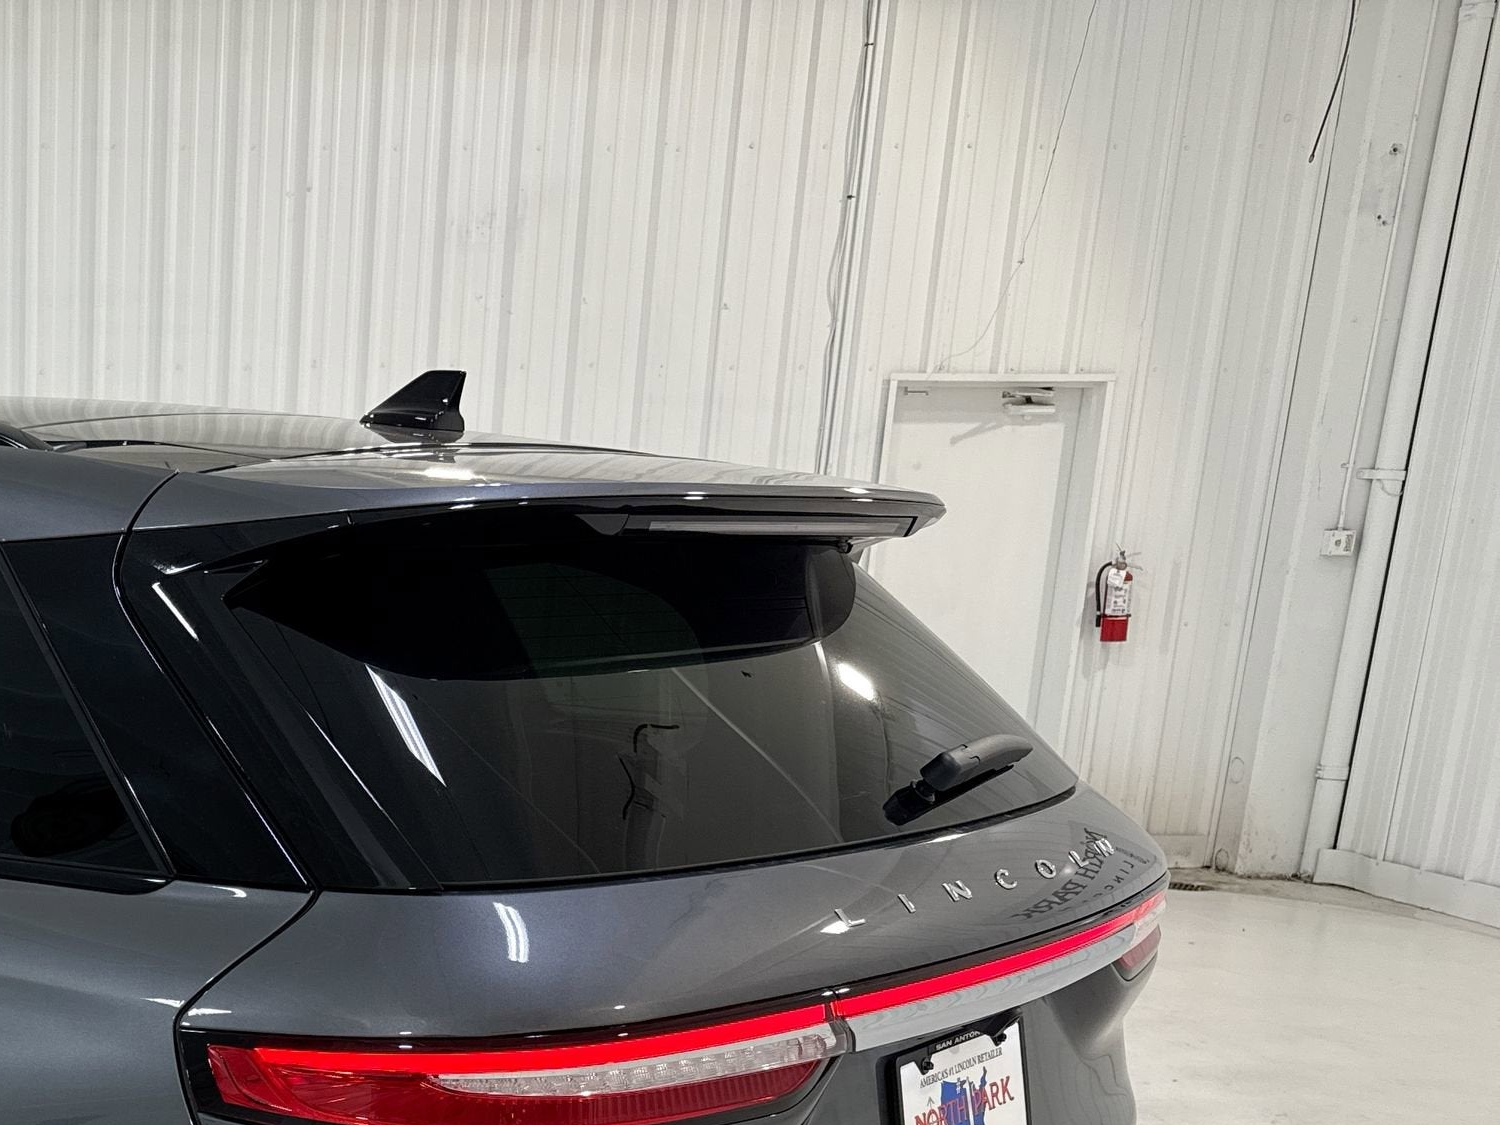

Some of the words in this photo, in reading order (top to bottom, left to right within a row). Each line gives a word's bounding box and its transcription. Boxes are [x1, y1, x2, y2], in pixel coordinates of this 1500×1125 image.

[834, 837, 1115, 928] LINCOLN
[935, 1039, 953, 1051] SAN
[954, 1030, 981, 1044] ANTON
[954, 1057, 977, 1075] LINCOLN
[977, 1047, 1003, 1065] RETAILER
[971, 1075, 1015, 1114] PARK
